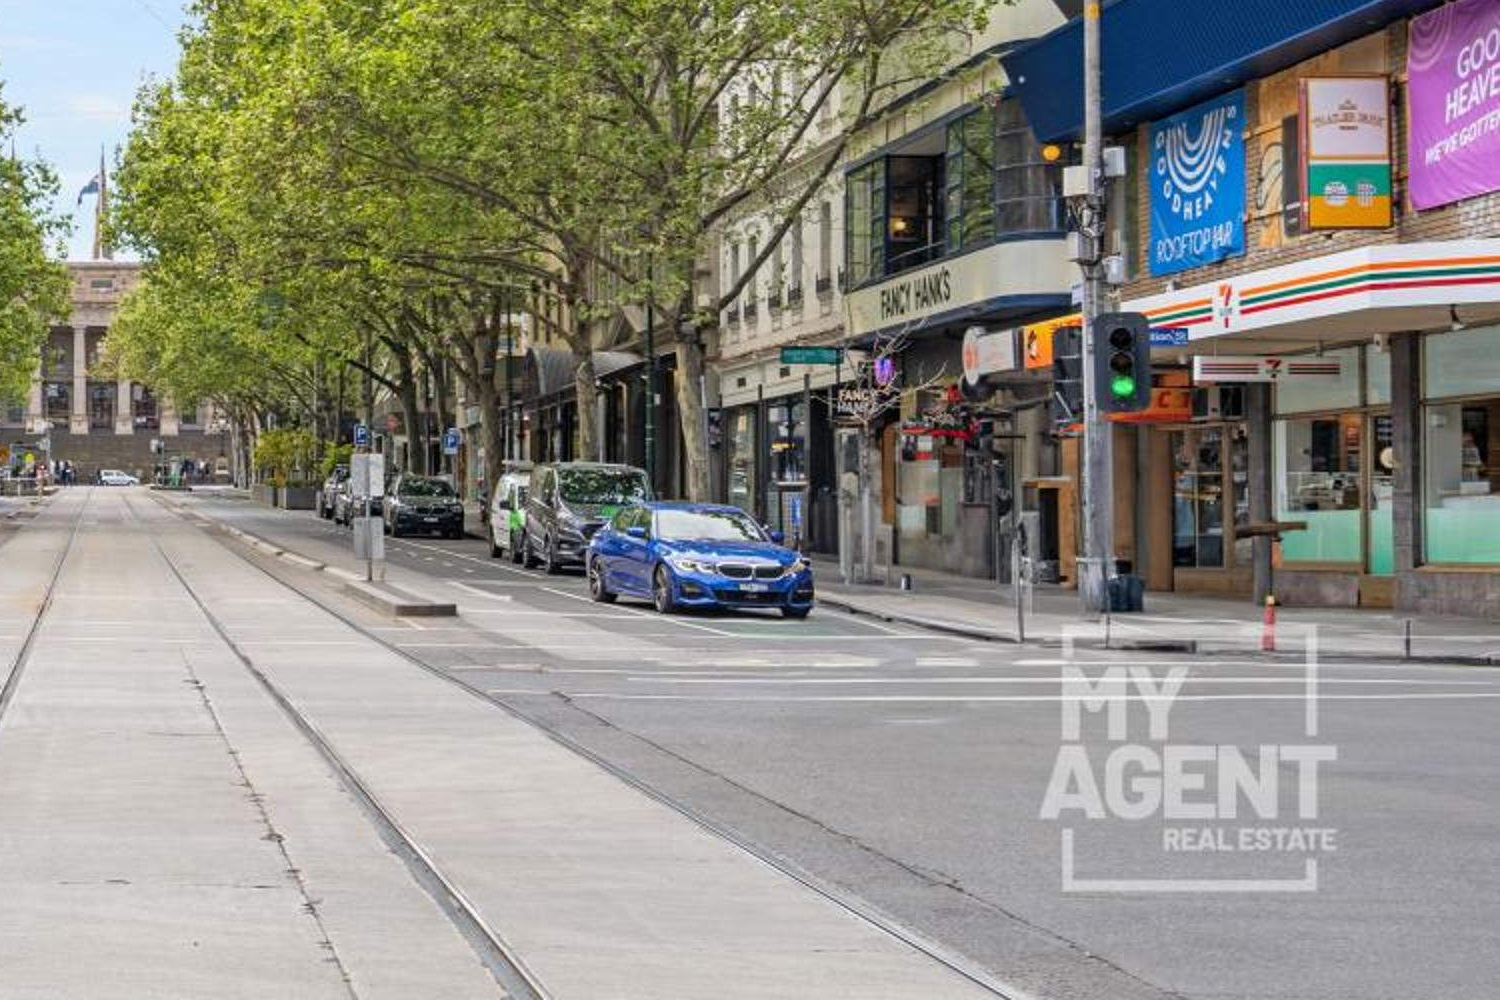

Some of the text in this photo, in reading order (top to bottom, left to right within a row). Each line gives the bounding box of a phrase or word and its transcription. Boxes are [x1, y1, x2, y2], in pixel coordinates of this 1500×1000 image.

[1157, 228, 1211, 264] ROOFTOP
[881, 266, 951, 320] FANCY HANK'S
